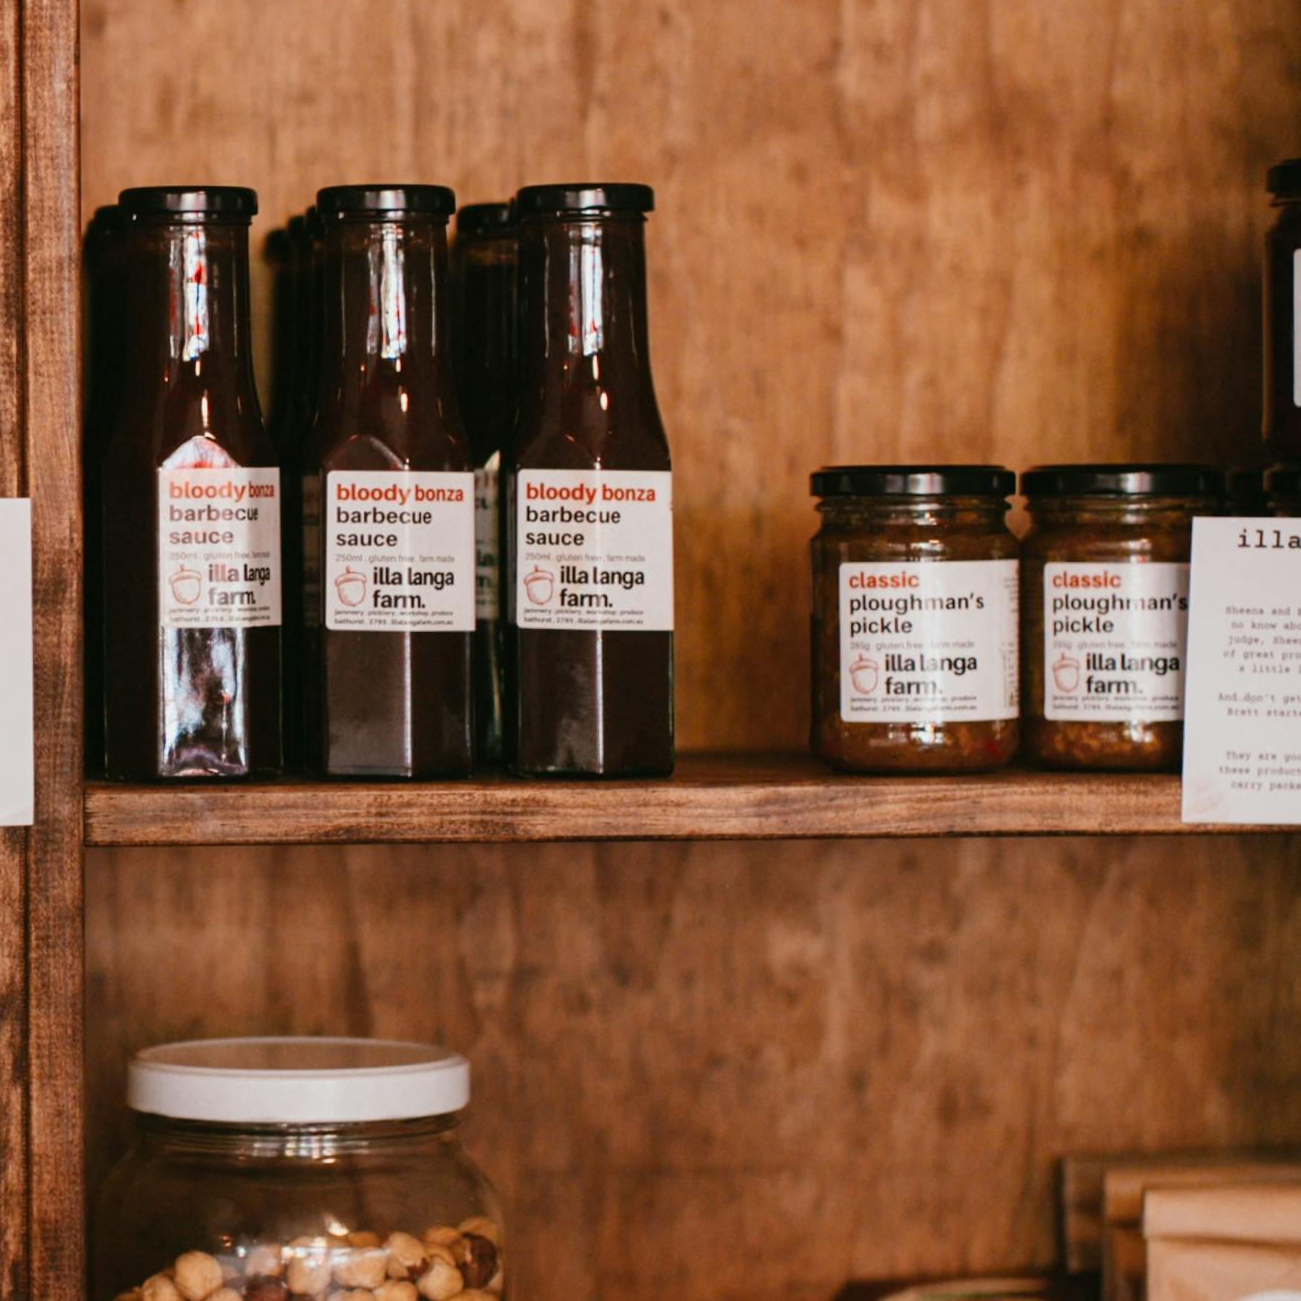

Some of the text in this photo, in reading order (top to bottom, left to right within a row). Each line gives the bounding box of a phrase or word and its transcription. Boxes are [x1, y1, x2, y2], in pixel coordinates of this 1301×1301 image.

[169, 480, 274, 502] bloody bonza
[336, 484, 464, 505] bloody bonza
[526, 483, 656, 505] bloody bonza
[169, 504, 258, 521] barbecue
[337, 507, 432, 524] barbecue
[526, 506, 621, 524] barbecue
[169, 530, 234, 544] sauce
[336, 533, 398, 547] sauce
[525, 532, 585, 545] sauce
[1237, 528, 1301, 549] illa
[209, 564, 270, 586] illa langa
[373, 567, 455, 590] illa langa
[560, 566, 645, 590] illa langa
[849, 571, 920, 589] classic
[1052, 570, 1121, 588] classic
[209, 588, 256, 605] farm.
[373, 589, 426, 608] farm.
[560, 588, 613, 608] farm.
[850, 592, 985, 616] ploughman's
[1052, 593, 1188, 615] ploughman's
[850, 617, 913, 638] pickle
[1053, 616, 1115, 637] pickle
[885, 654, 978, 675] illa langa
[1086, 653, 1180, 675] illa langa
